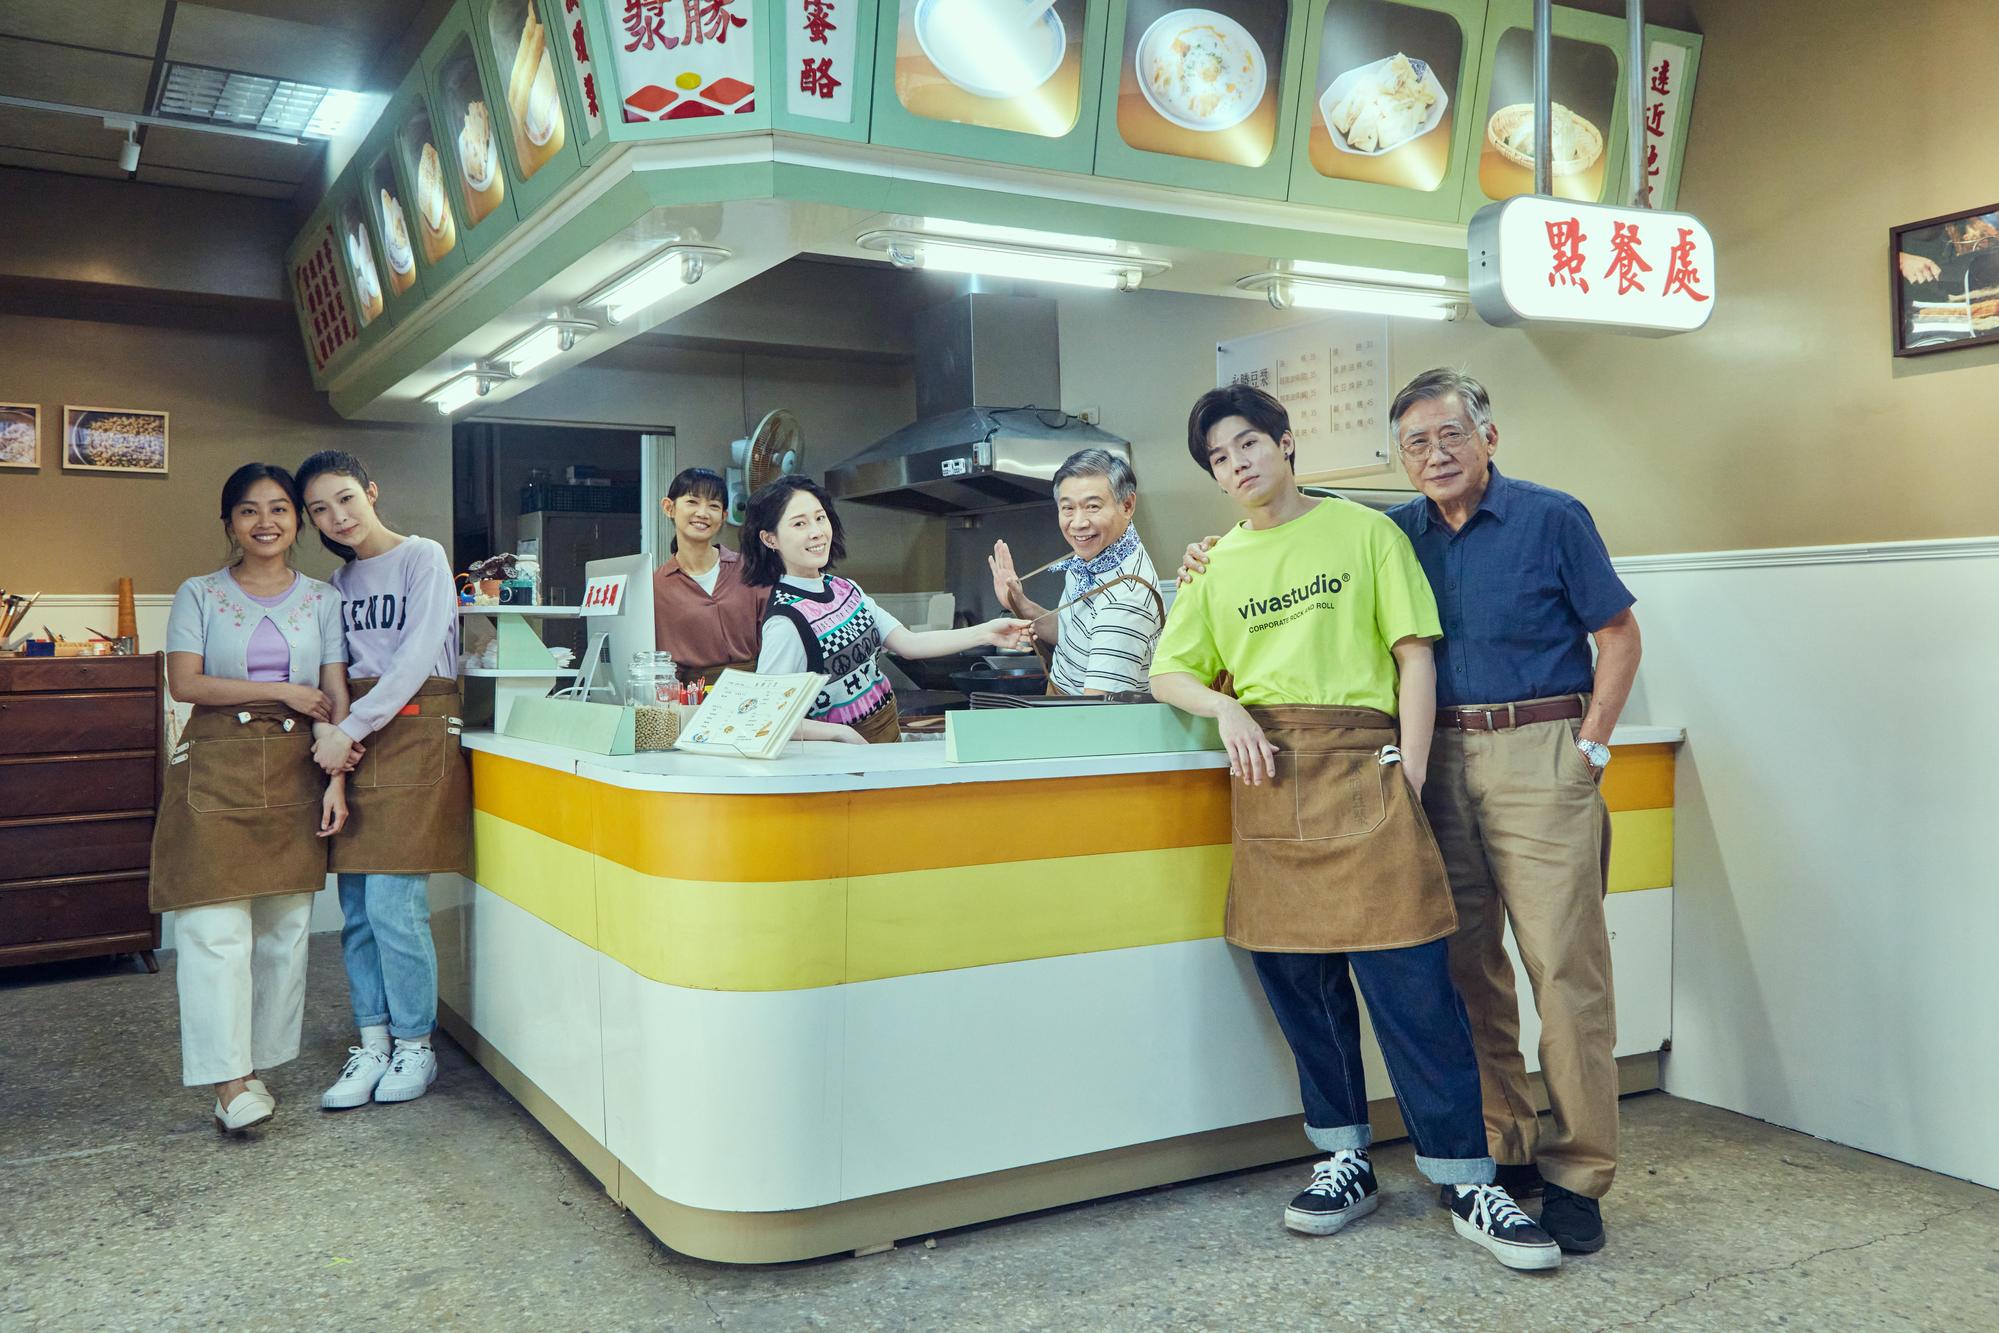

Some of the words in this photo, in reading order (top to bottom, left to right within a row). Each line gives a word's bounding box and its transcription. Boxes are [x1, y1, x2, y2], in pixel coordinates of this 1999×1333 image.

[1544, 217, 1710, 302] 點餐處
[1248, 617, 1290, 634] CORPORATE
[1316, 602, 1335, 610] ROLL
